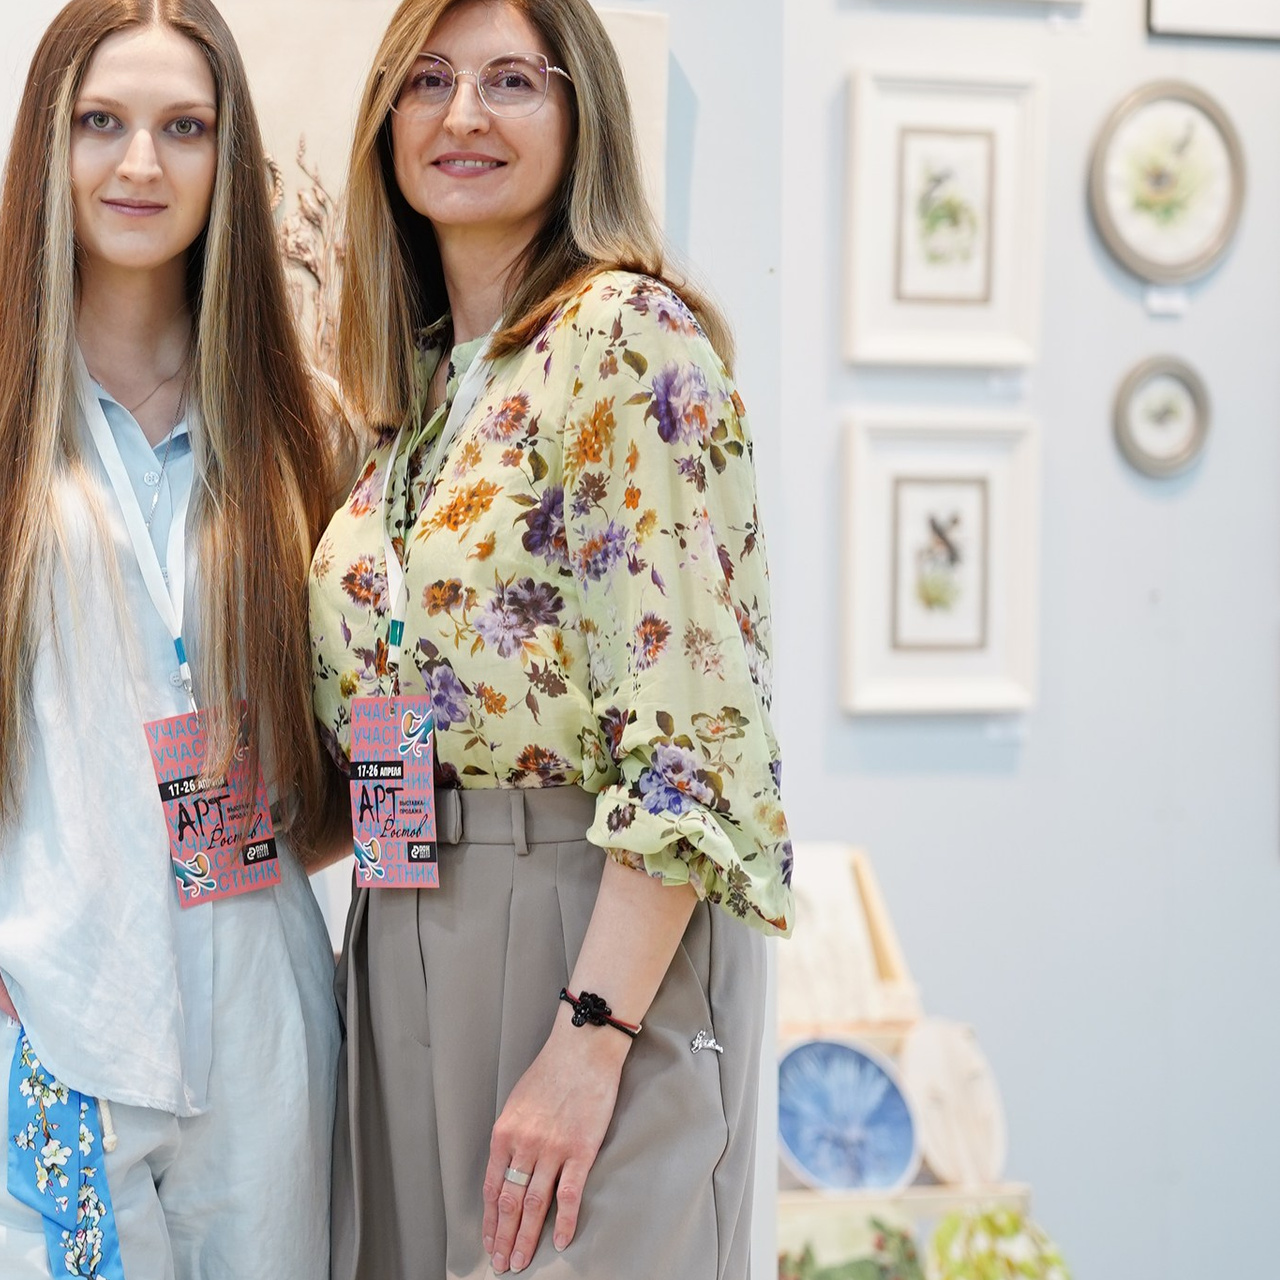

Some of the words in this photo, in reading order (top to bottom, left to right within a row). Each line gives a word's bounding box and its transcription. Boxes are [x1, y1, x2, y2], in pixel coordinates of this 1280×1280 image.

[357, 764, 379, 778] 17-26
[380, 766, 402, 777] АПРЕЛЯ
[168, 780, 196, 797] 17-26
[359, 784, 404, 824] АРТ
[177, 794, 231, 842] АРТ
[380, 814, 429, 839] Ростов
